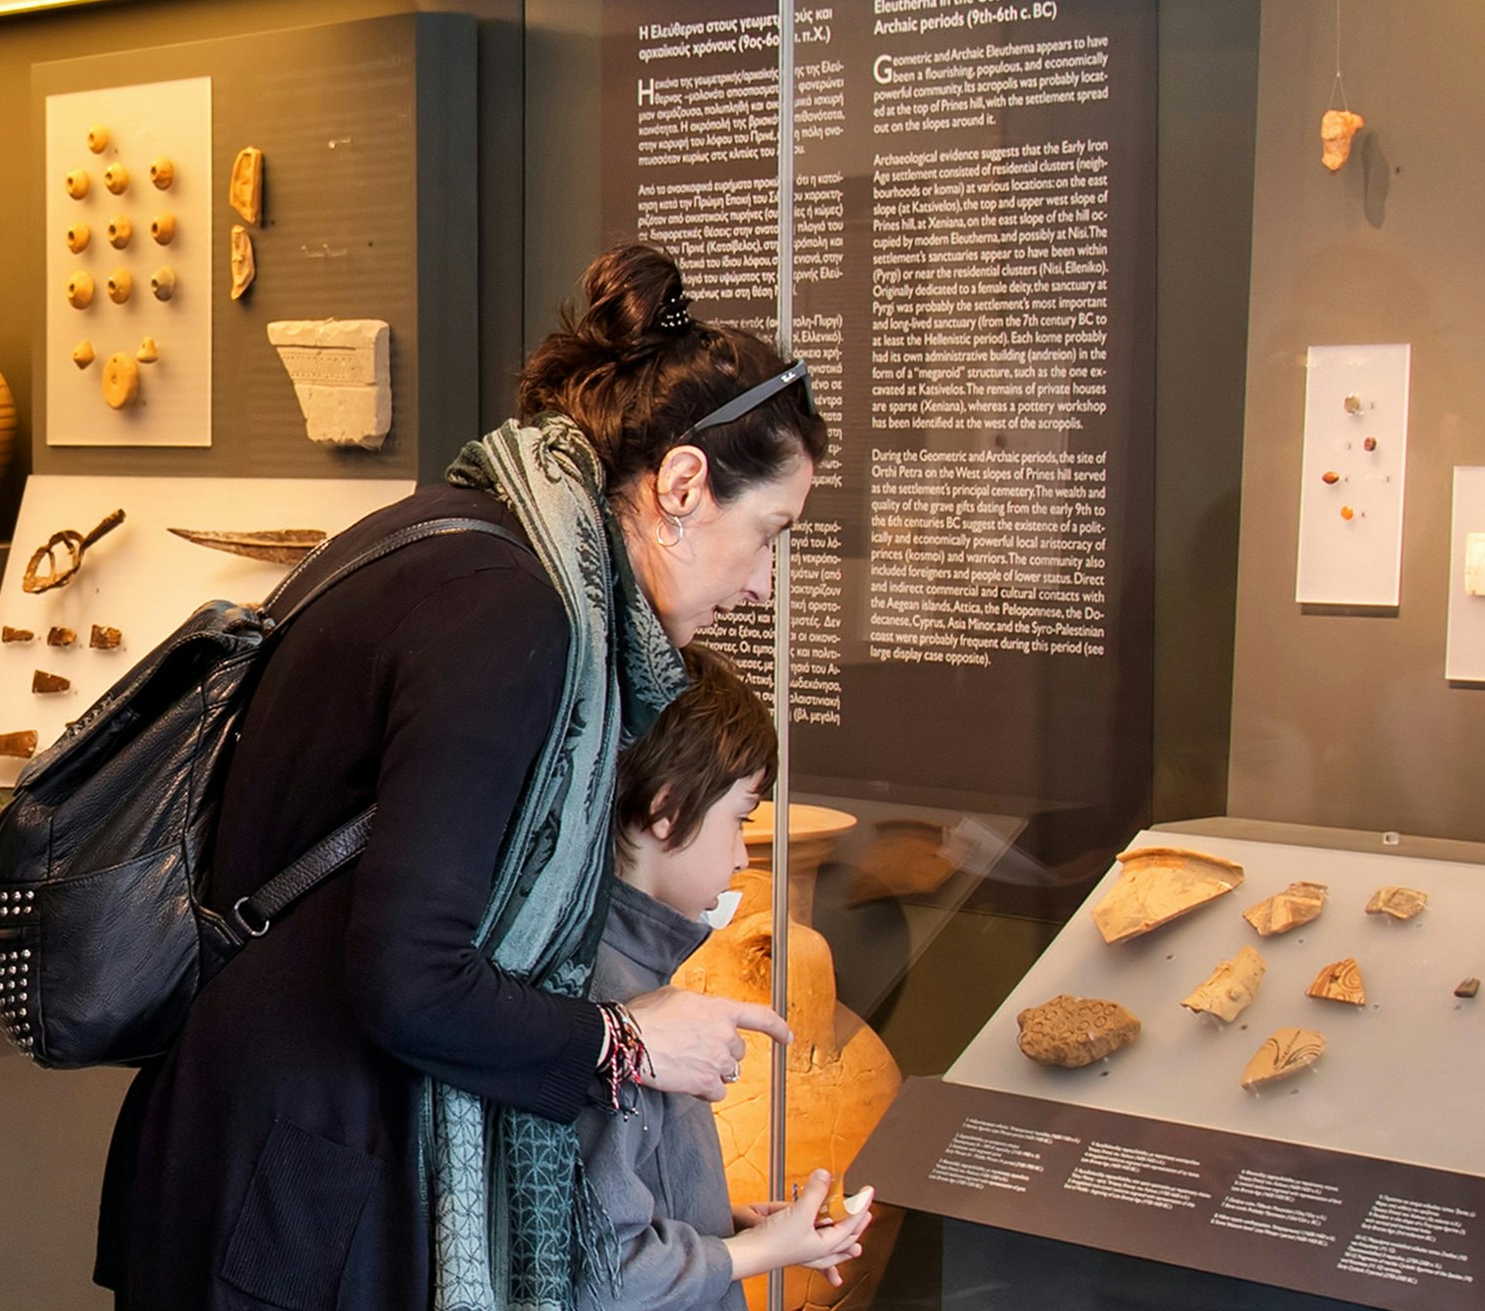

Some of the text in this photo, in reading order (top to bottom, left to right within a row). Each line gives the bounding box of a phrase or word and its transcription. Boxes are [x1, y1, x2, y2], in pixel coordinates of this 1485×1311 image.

[873, 1, 1057, 35] Archaic periods (9th-6th c. BC)
[933, 48, 951, 63] and
[949, 46, 984, 62] Archaic
[985, 42, 1035, 58] Eleutherna
[1036, 40, 1072, 56] appears
[1073, 37, 1085, 50] to
[1086, 34, 1108, 49] have
[890, 69, 915, 83] been
[916, 71, 923, 81] a
[1023, 57, 1042, 72] and
[1043, 52, 1109, 71] economically
[872, 84, 912, 104] powerful
[976, 76, 1018, 95] acropolis
[1019, 78, 1037, 89] was
[1038, 71, 1080, 91] probably
[1080, 70, 1108, 85] locat-
[872, 103, 885, 118] ed
[885, 104, 895, 117] at
[896, 101, 912, 116] the
[912, 102, 929, 117] top
[929, 99, 940, 114] of
[940, 98, 968, 113] Prines
[984, 94, 1006, 109] with
[1007, 93, 1024, 108] the
[1024, 90, 1075, 106] settlement
[1076, 86, 1109, 105] spread
[872, 121, 890, 134] out
[890, 122, 904, 133] on
[904, 117, 920, 132] the
[921, 116, 950, 133] slopes
[951, 112, 984, 128] around
